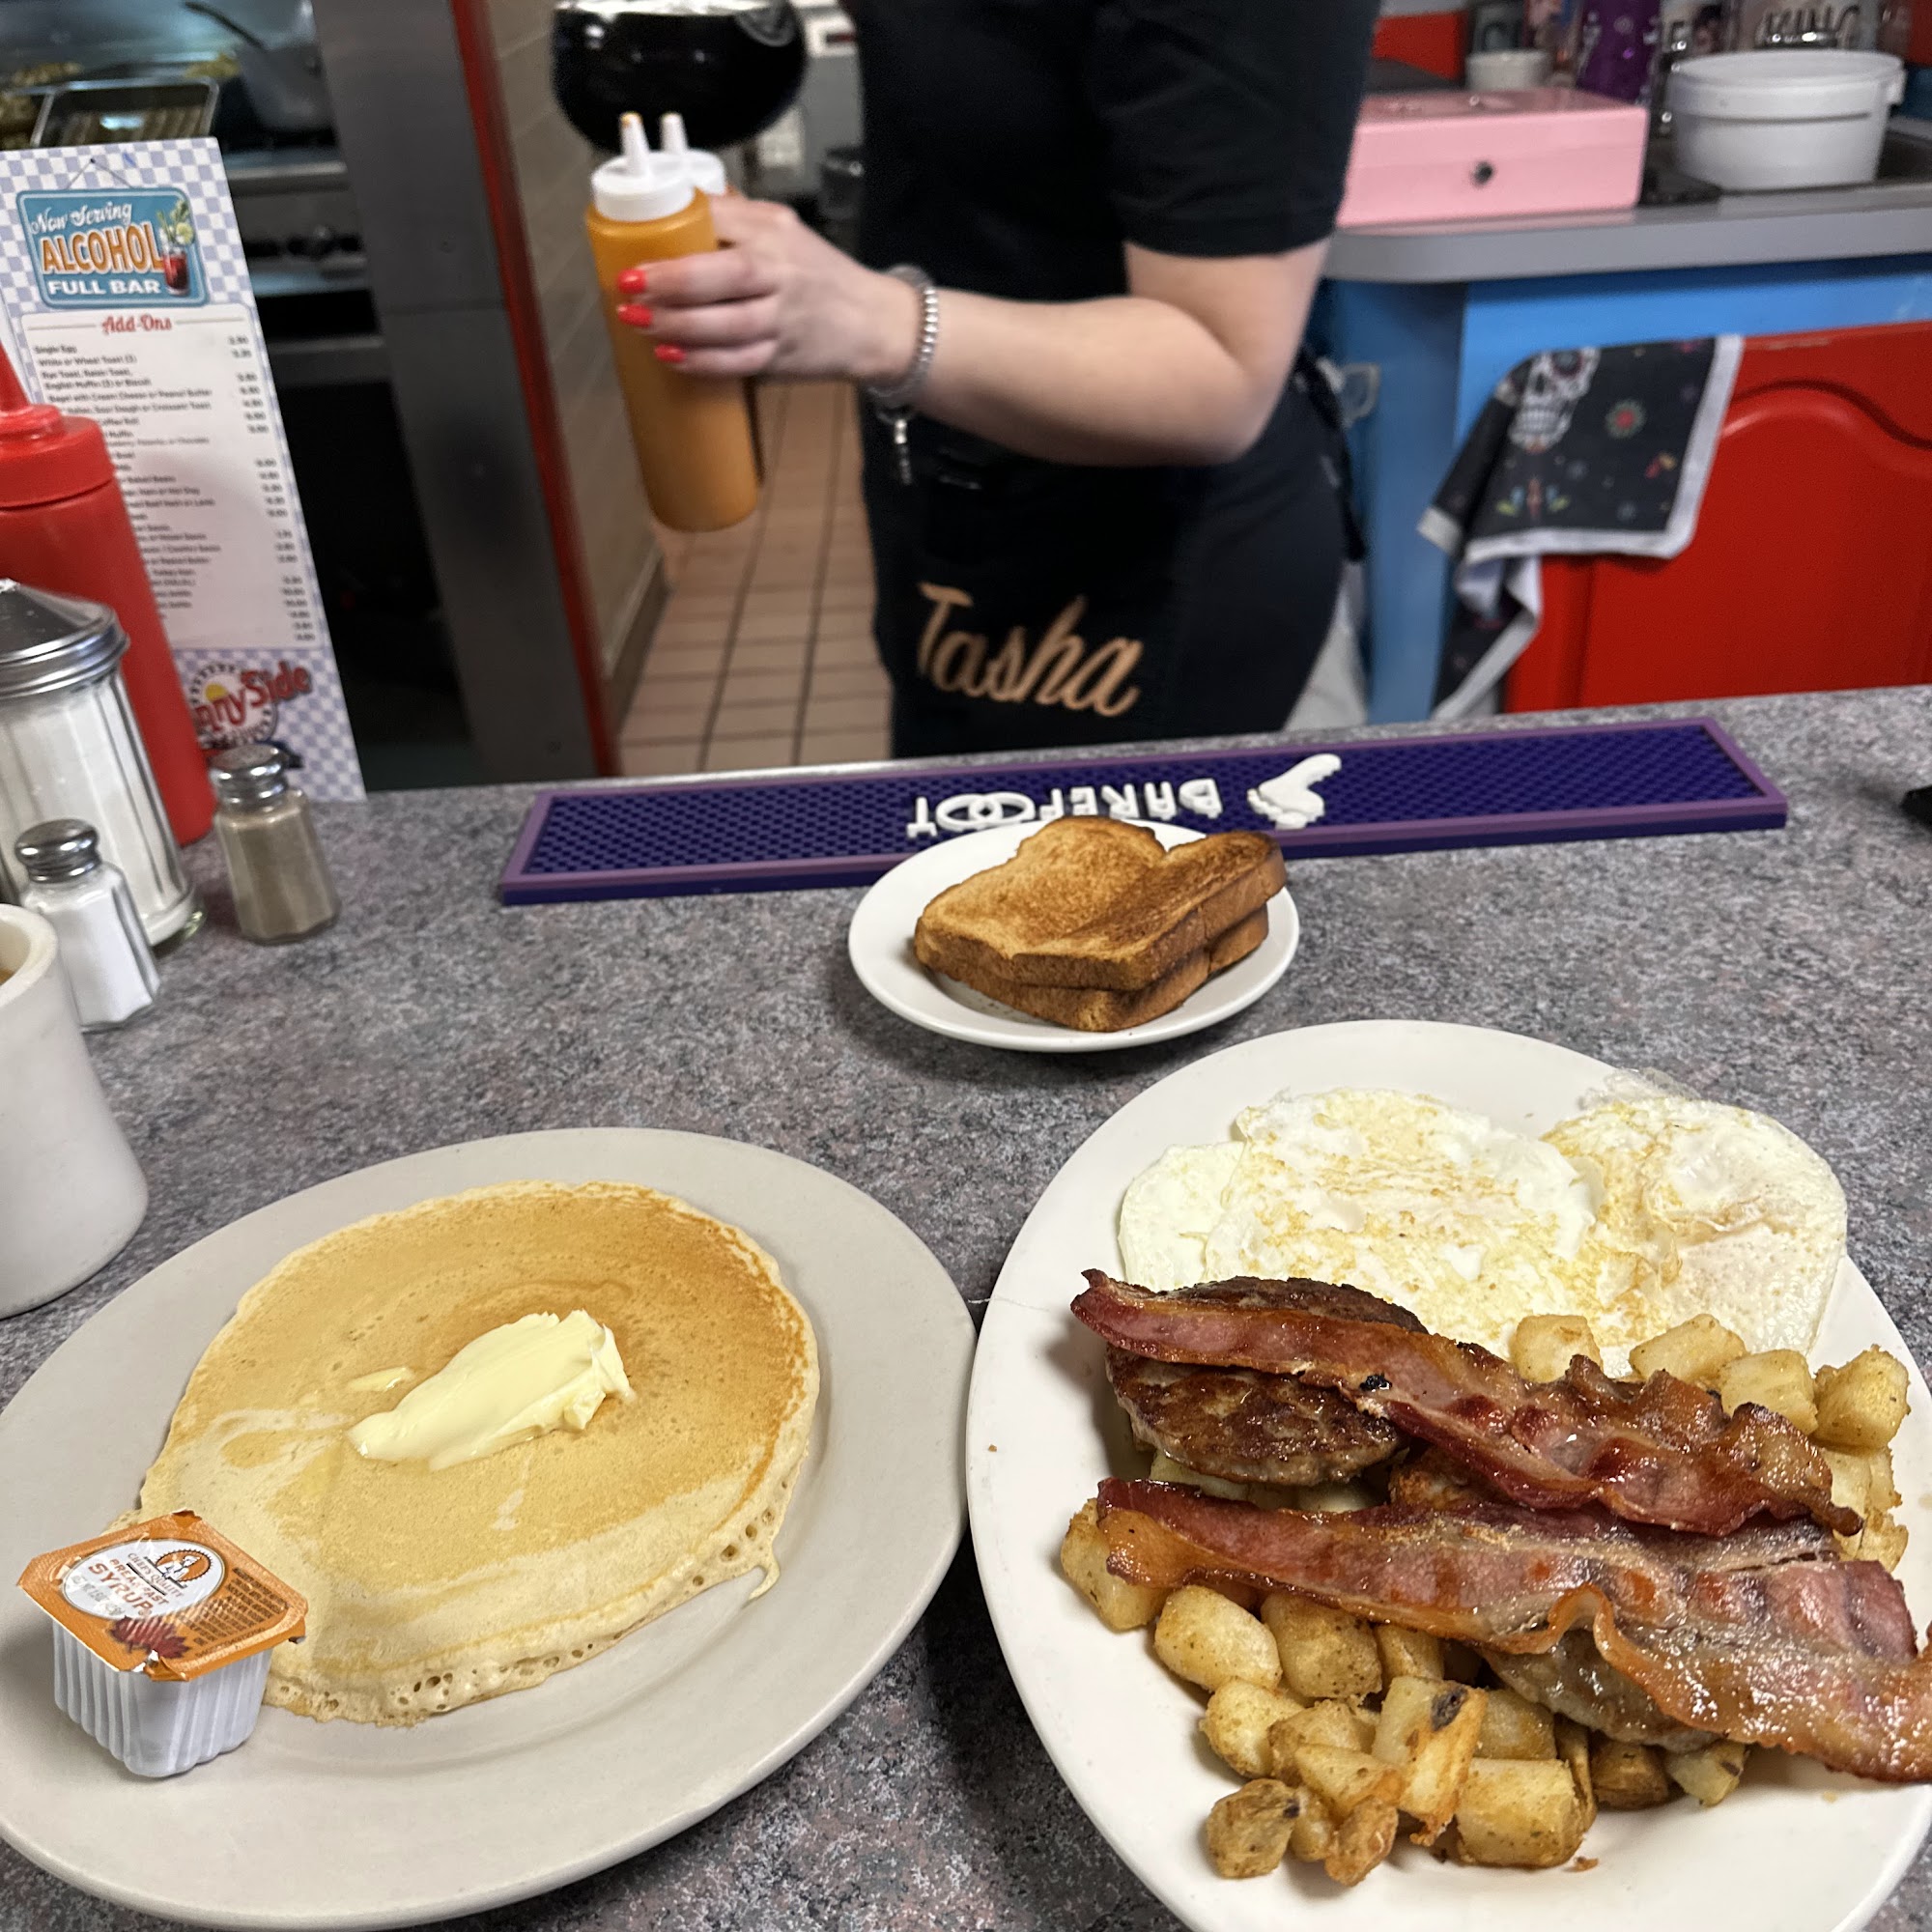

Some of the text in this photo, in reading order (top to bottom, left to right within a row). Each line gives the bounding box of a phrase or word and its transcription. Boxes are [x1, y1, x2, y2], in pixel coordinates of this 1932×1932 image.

[30, 201, 132, 235] Now Serving
[41, 221, 164, 275] ALCOHOL
[47, 278, 161, 295] FULL BAR
[101, 314, 172, 335] Add-Ons
[917, 581, 1144, 718] Tasha
[907, 778, 1224, 838] BAREFOOT
[88, 1562, 154, 1611] SYRUP
[109, 1558, 170, 1605] BREAFAST
